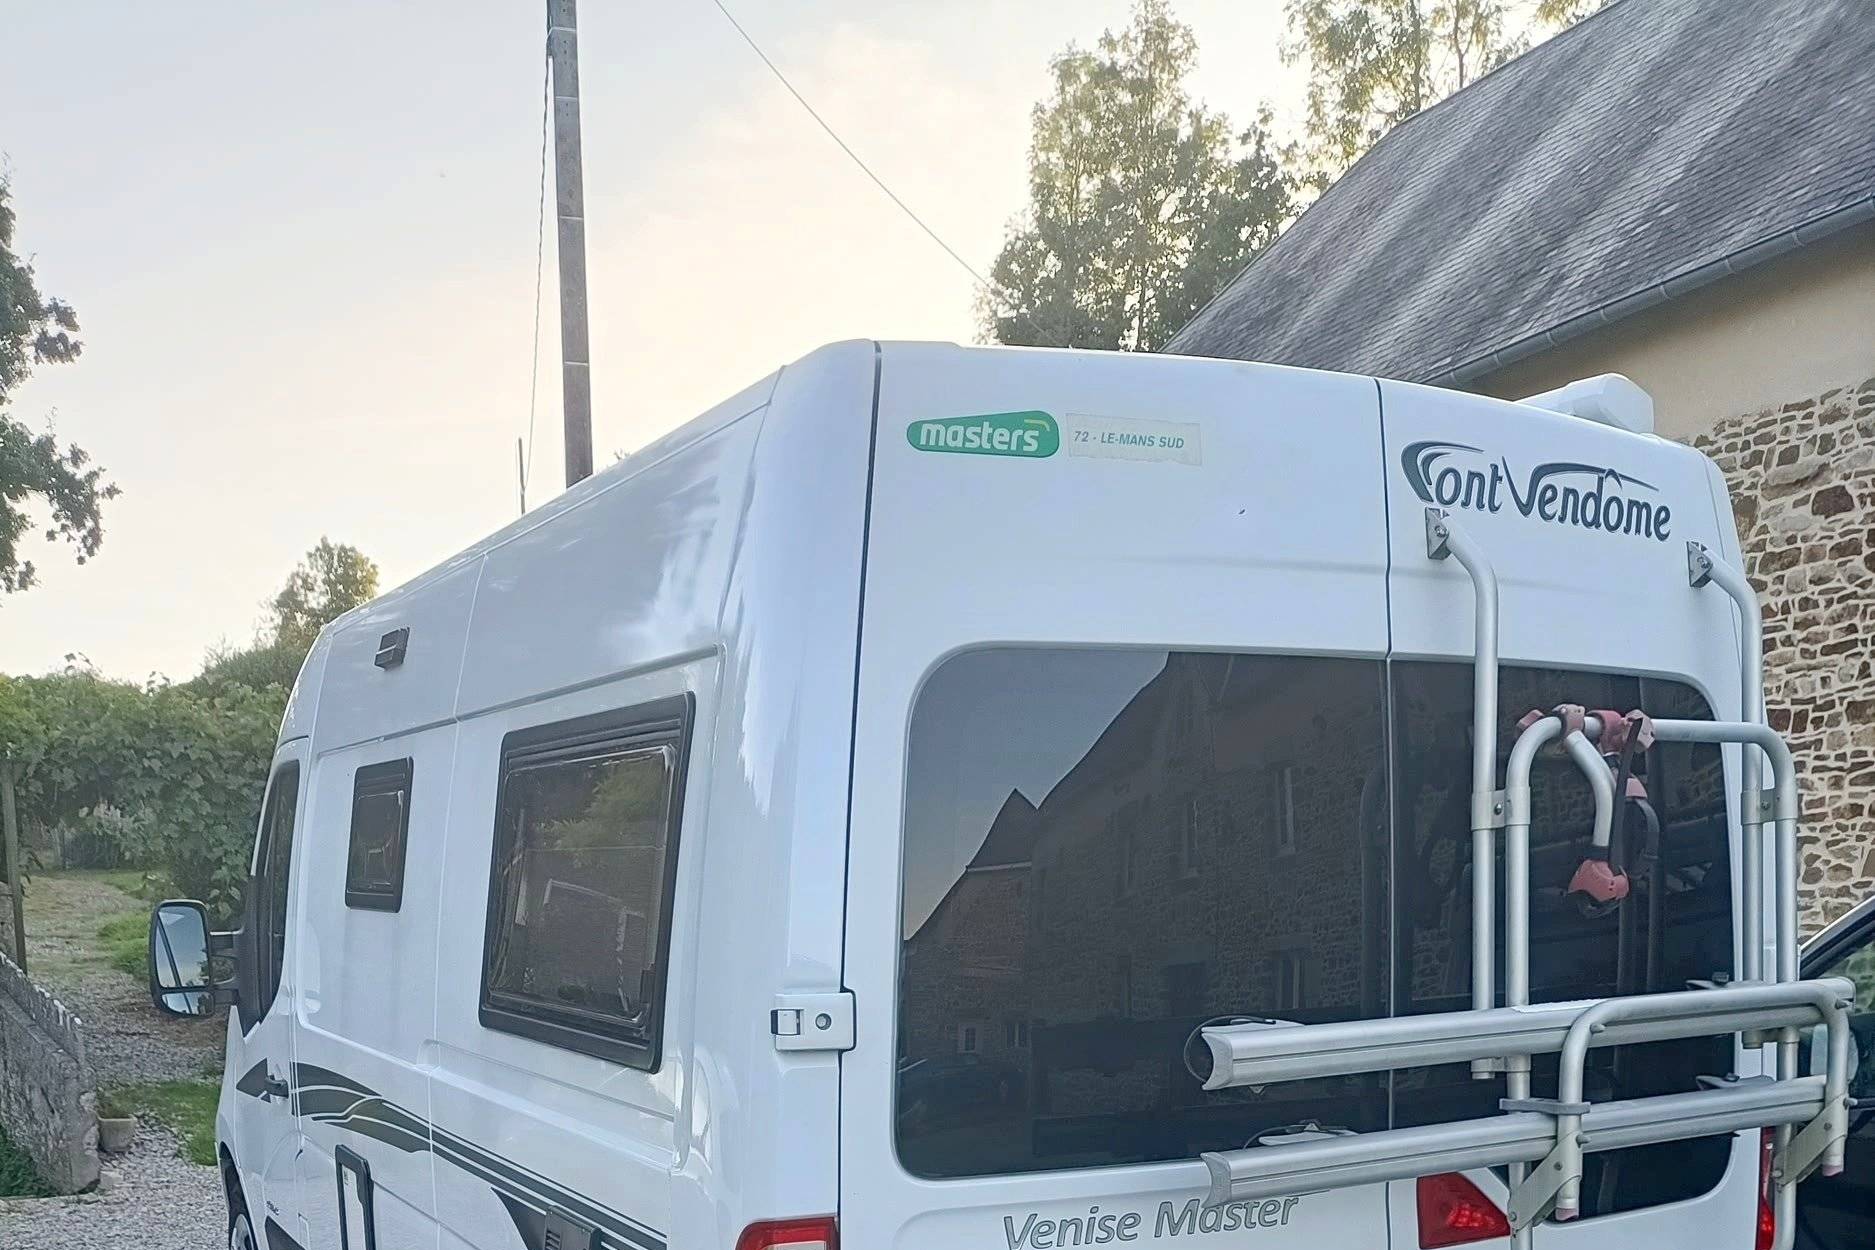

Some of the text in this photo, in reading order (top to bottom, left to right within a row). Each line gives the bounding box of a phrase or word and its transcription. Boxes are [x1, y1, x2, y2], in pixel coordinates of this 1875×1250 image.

[920, 421, 1040, 452] masters
[1074, 430, 1089, 443] 72
[1101, 431, 1156, 448] LE-MANS
[1159, 436, 1185, 449] SUD
[1153, 1197, 1300, 1238] Master
